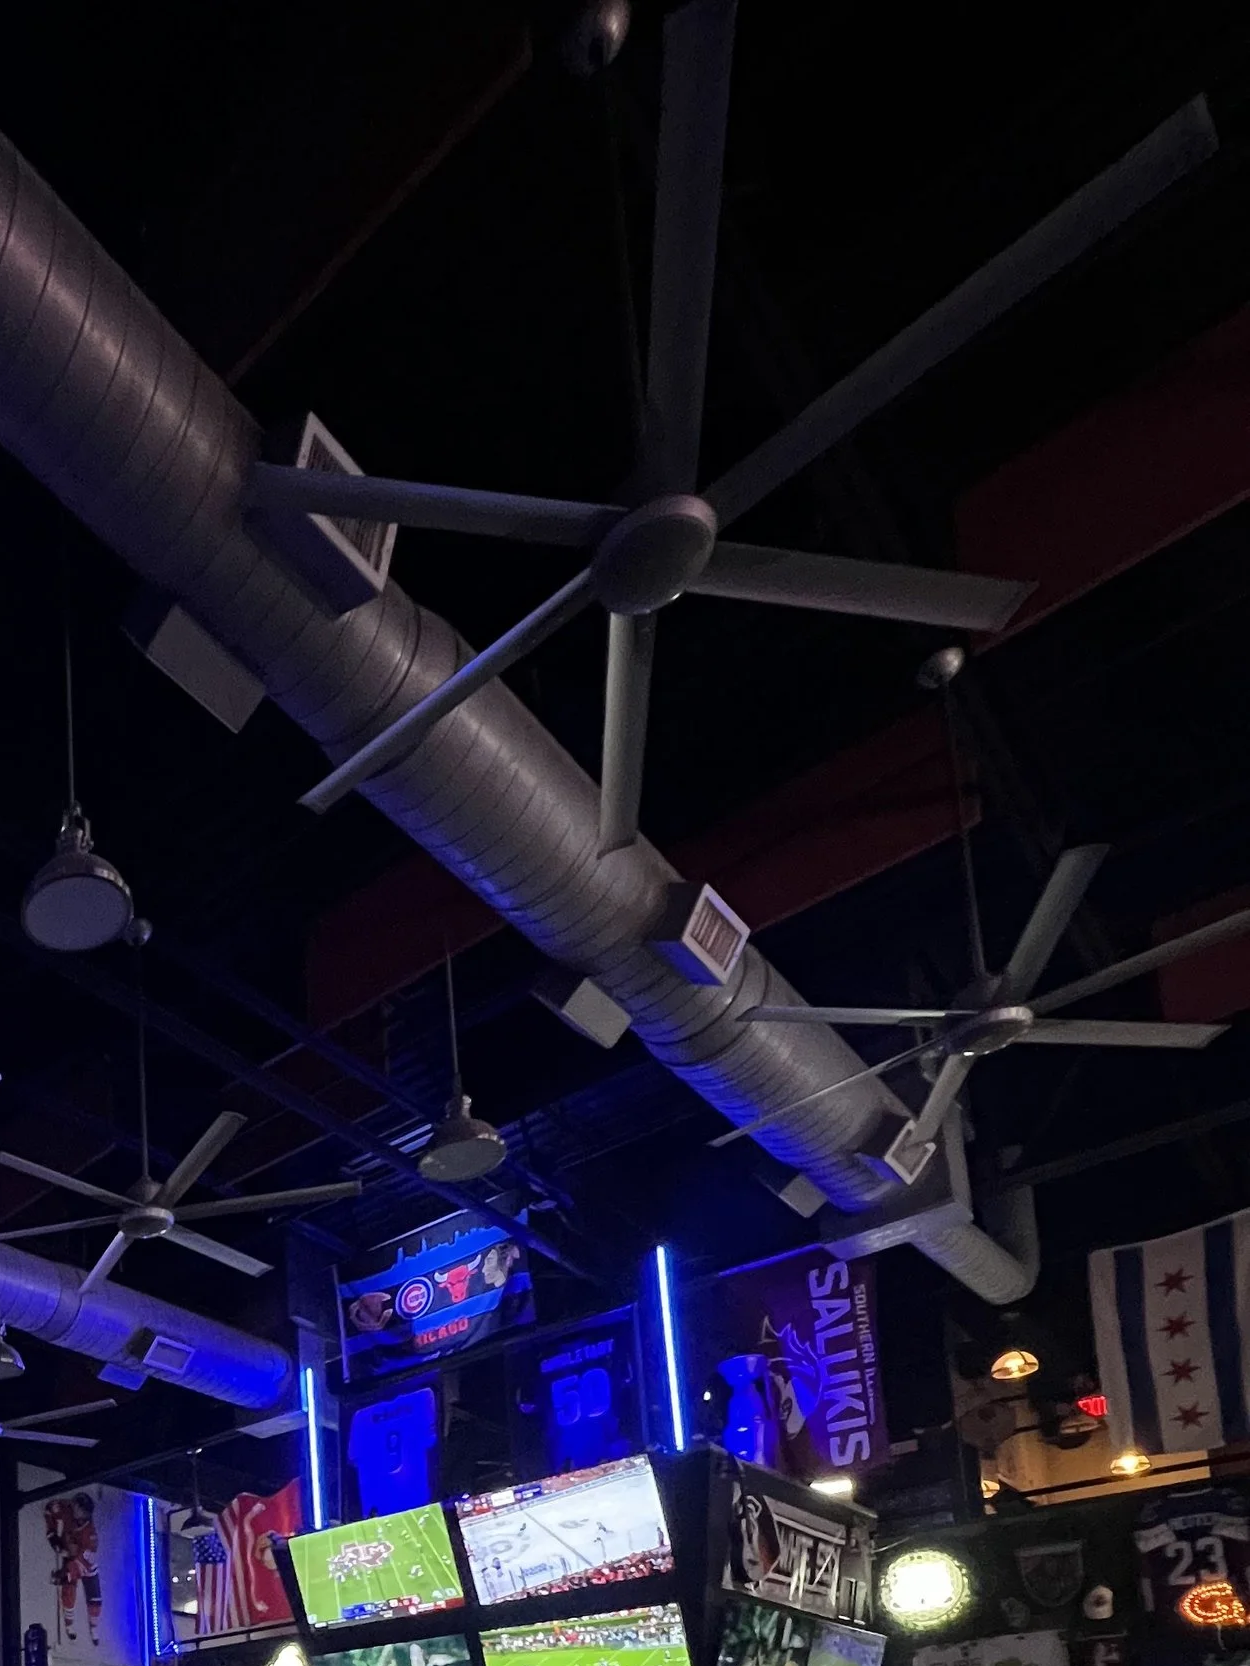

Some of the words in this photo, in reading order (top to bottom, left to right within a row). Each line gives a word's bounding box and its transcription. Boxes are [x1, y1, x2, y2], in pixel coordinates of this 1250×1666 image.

[853, 1283, 877, 1364] SOUTHERN
[551, 1367, 610, 1426] 50
[808, 1261, 871, 1467] SALUKIS
[1165, 1536, 1228, 1586] 23
